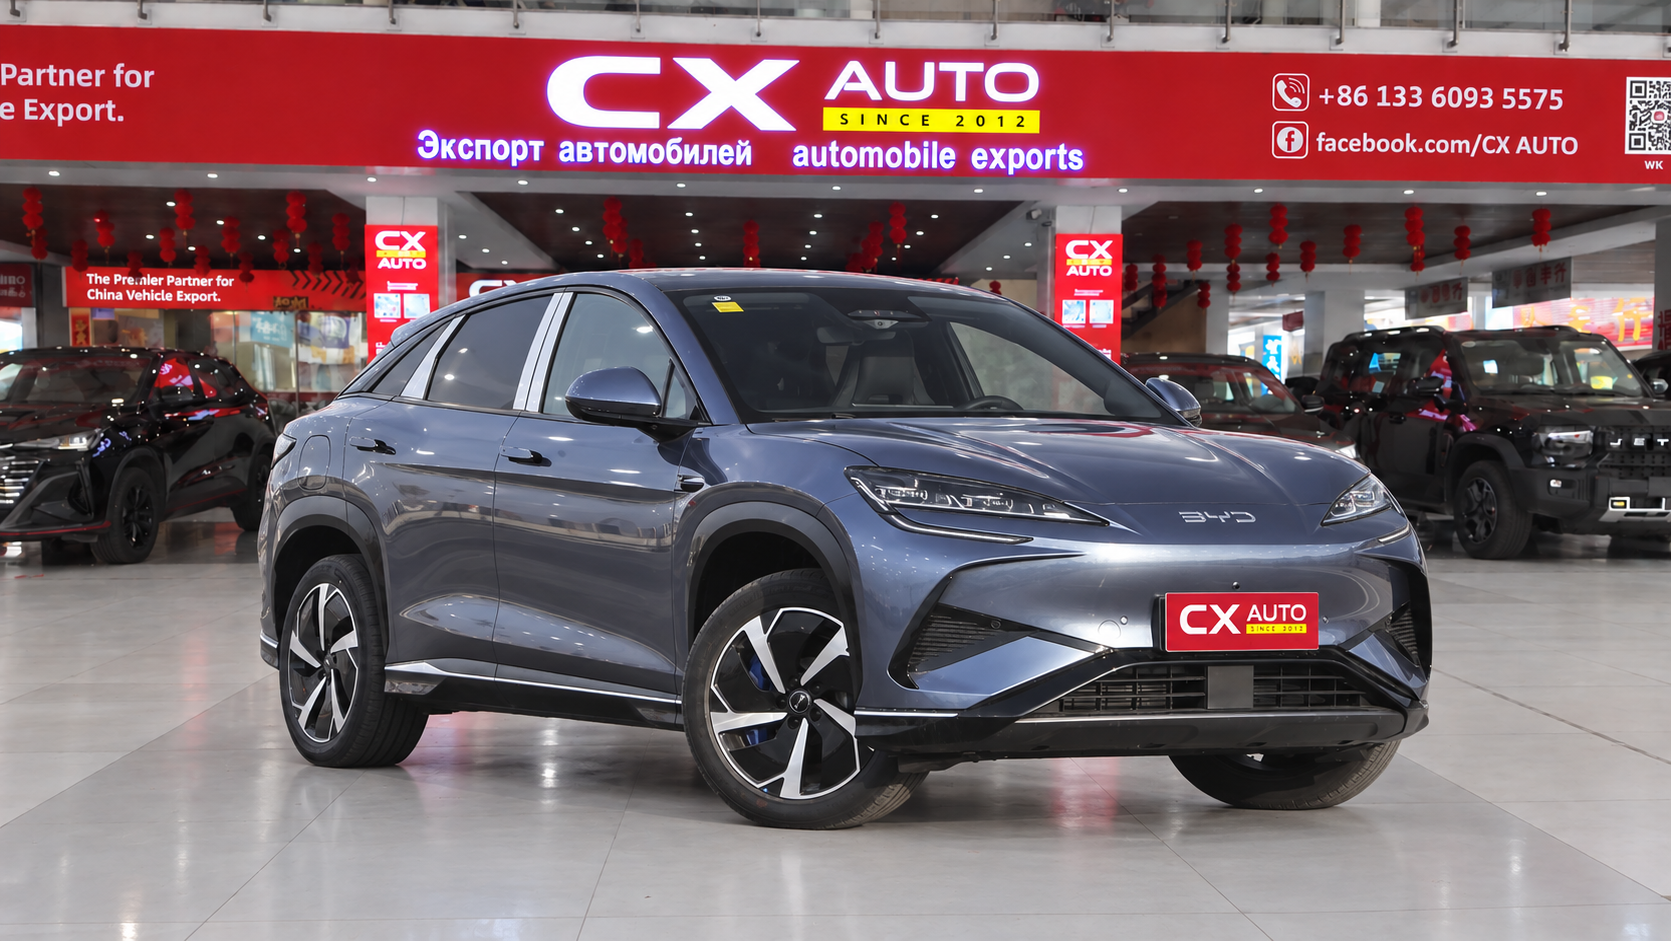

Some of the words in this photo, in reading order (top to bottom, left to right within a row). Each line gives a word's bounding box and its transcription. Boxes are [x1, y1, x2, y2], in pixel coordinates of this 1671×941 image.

[0, 63, 106, 87] Partner
[113, 62, 155, 88] for
[824, 60, 1040, 103] AUTO
[546, 56, 800, 132] CX
[1318, 84, 1368, 107] +86
[1376, 85, 1423, 108] 133
[1431, 86, 1494, 109] 6093
[1502, 87, 1563, 111] 5575
[24, 98, 124, 127] Export.
[840, 113, 930, 127] SINCE
[955, 115, 1026, 128] 2012
[417, 129, 545, 167] Экспорт
[558, 138, 752, 167] автомобилей
[1315, 131, 1511, 158] facebook.com/CX
[1515, 136, 1579, 156] AUTO
[792, 140, 956, 170] automobile
[971, 142, 1084, 176] exports
[1644, 160, 1664, 170] WK
[374, 230, 426, 252] CX
[1065, 239, 1114, 260] CX
[377, 257, 427, 270] AUTO
[1065, 265, 1113, 277] AUTO
[86, 273, 111, 286] The
[166, 275, 213, 288] Partner
[215, 275, 235, 288] for
[86, 288, 124, 302] China
[126, 289, 173, 302] Vehicle
[176, 290, 222, 305] Export.
[1178, 510, 1257, 524] BYD
[1179, 603, 1241, 635] CX
[1246, 603, 1307, 622] AUTO
